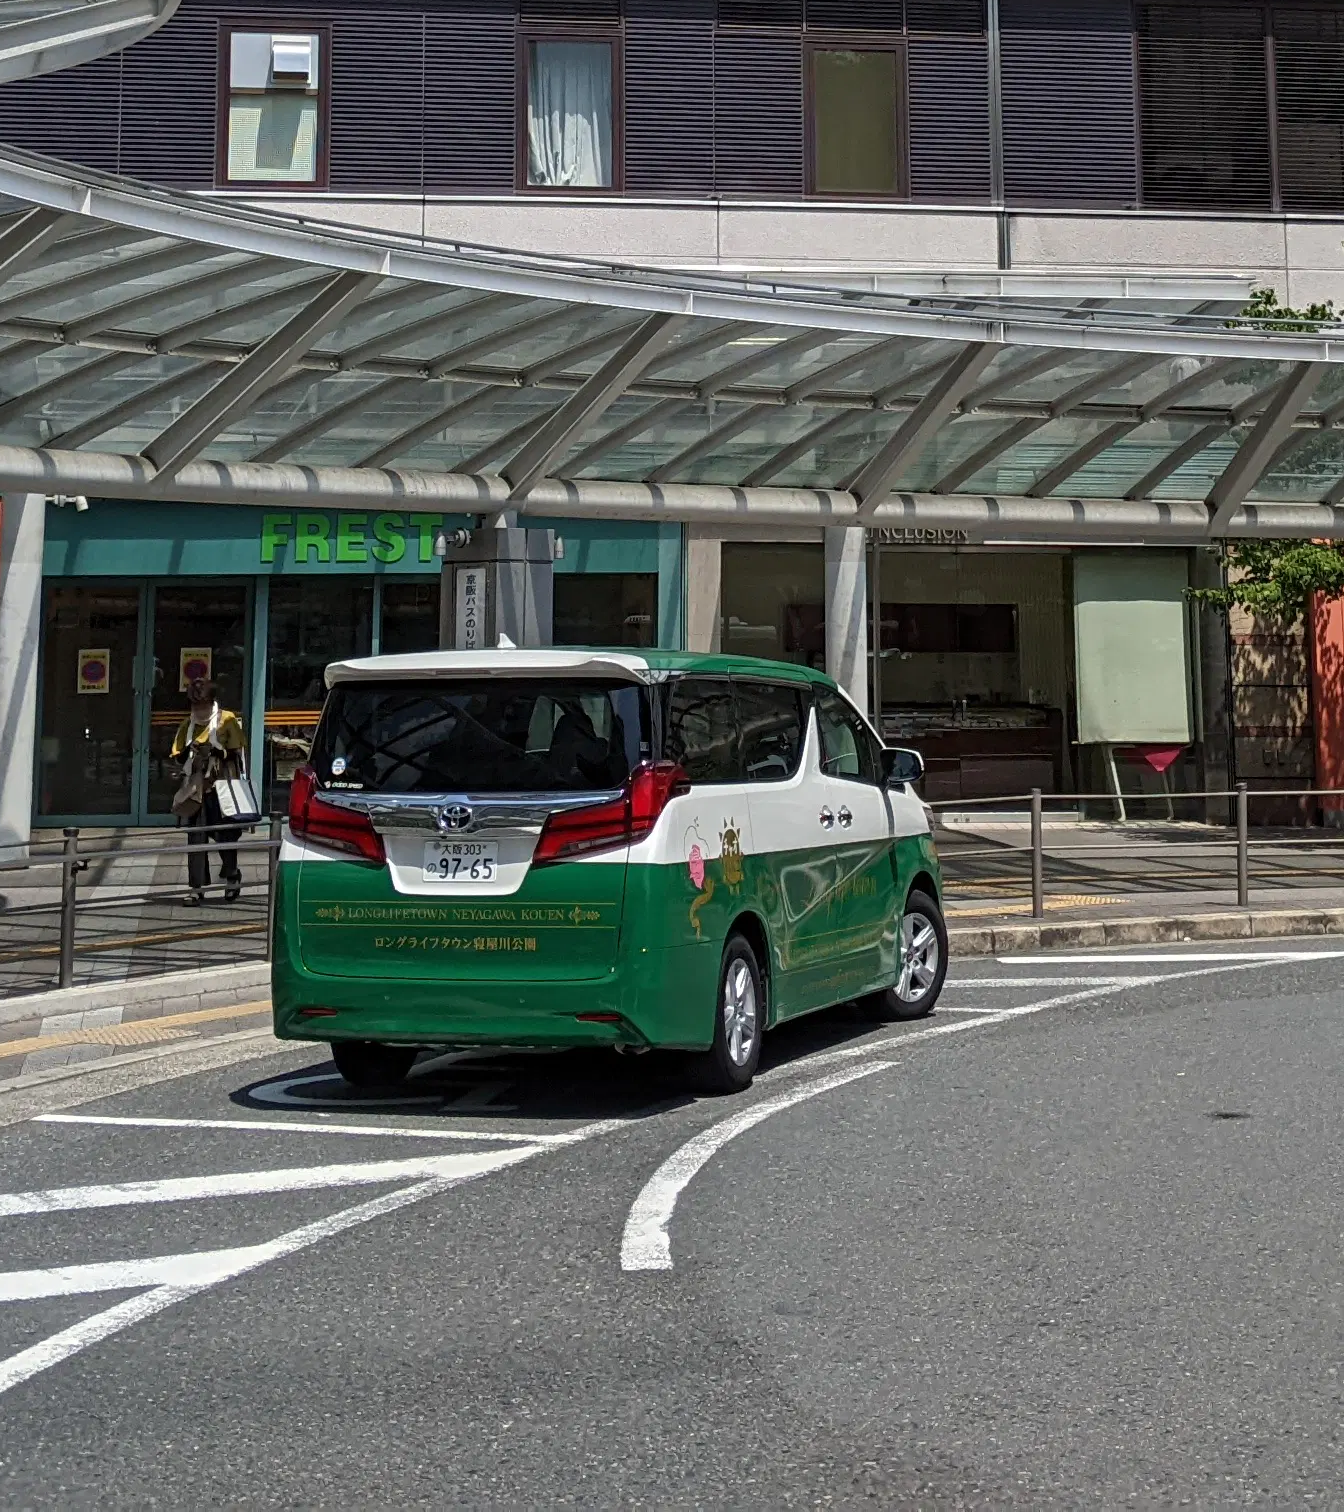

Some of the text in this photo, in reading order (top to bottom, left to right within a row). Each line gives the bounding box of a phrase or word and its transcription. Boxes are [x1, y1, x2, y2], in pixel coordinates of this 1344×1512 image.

[260, 512, 443, 563] FREST
[426, 857, 494, 879] の 97-65
[348, 909, 565, 921] LONGLIFETOWN NEYAGAWA KOUEN
[374, 936, 537, 951] ロングライフタウン寝屋川公園
